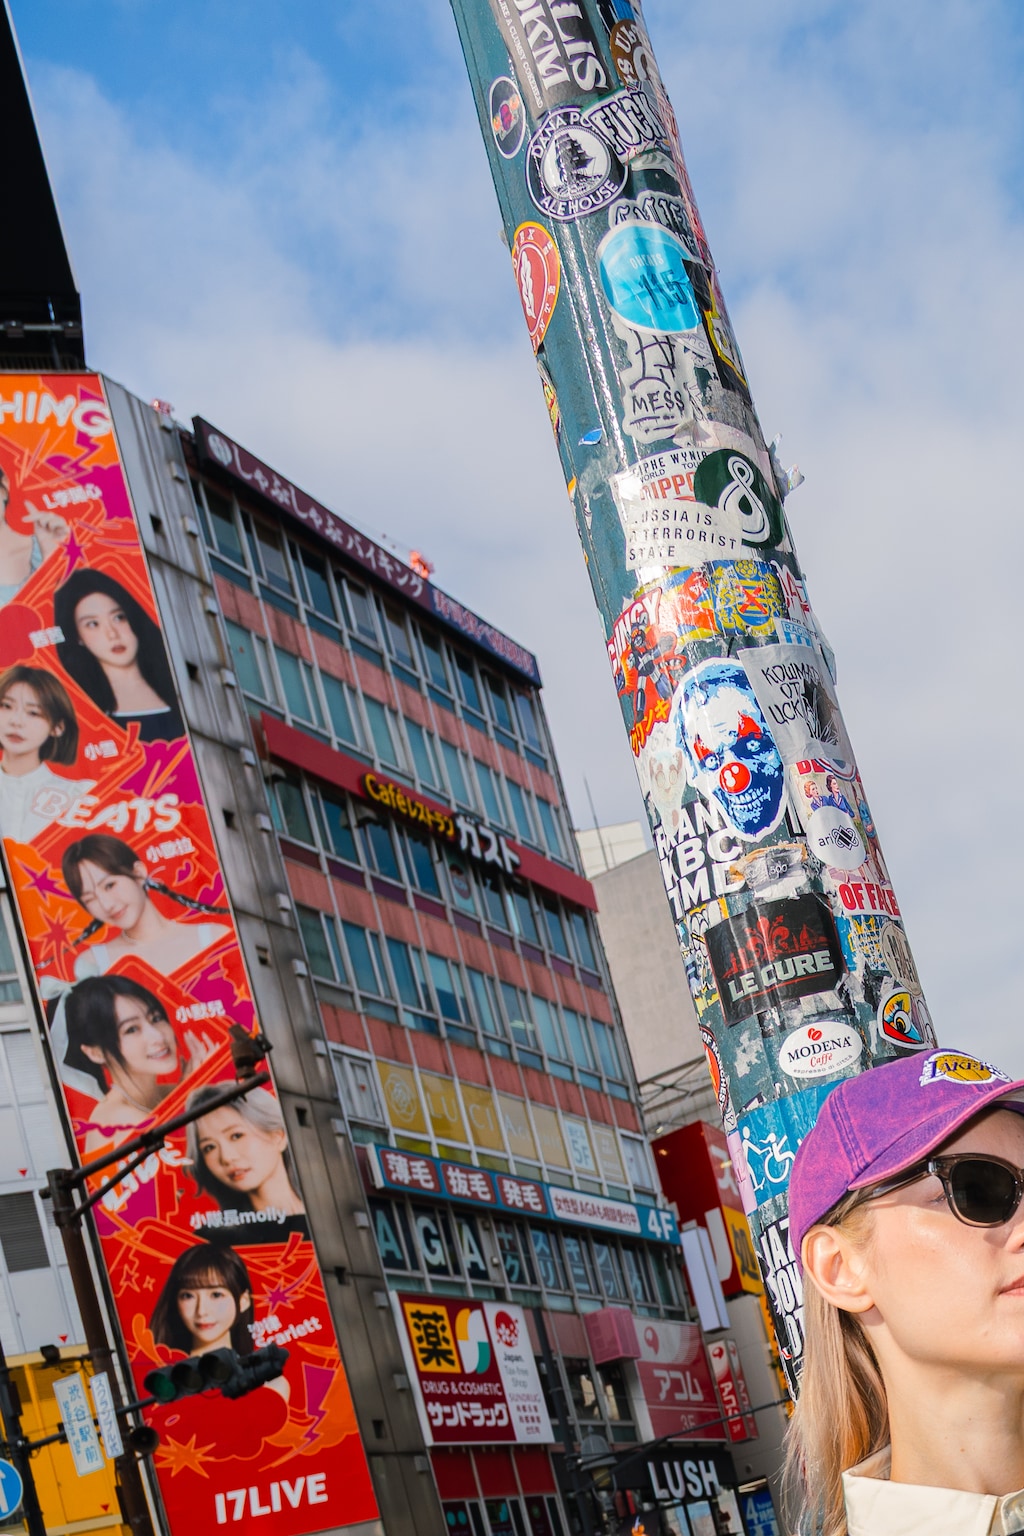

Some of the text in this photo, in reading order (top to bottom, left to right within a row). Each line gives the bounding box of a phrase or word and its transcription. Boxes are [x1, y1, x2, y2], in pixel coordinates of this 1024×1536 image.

[509, 26, 526, 62] CLUMSY
[550, 0, 609, 91] LIS
[631, 390, 685, 415] MESS
[634, 509, 713, 526] USSIA IS
[35, 789, 182, 833] BEATS
[456, 814, 522, 875] ガスト
[839, 883, 865, 911] OF
[728, 950, 834, 1002] LE CURE
[787, 1037, 852, 1064] MODENA
[387, 1154, 435, 1190] 薄毛
[503, 1181, 542, 1212] 発毛
[647, 1209, 675, 1241] 4F
[375, 1209, 485, 1272] AGA
[410, 1310, 455, 1367] 薬
[422, 1380, 502, 1396] DRUG & COSMETIC
[653, 1368, 704, 1403] アコム
[427, 1402, 509, 1427] サンドラッグ
[648, 1459, 720, 1500] LUSH
